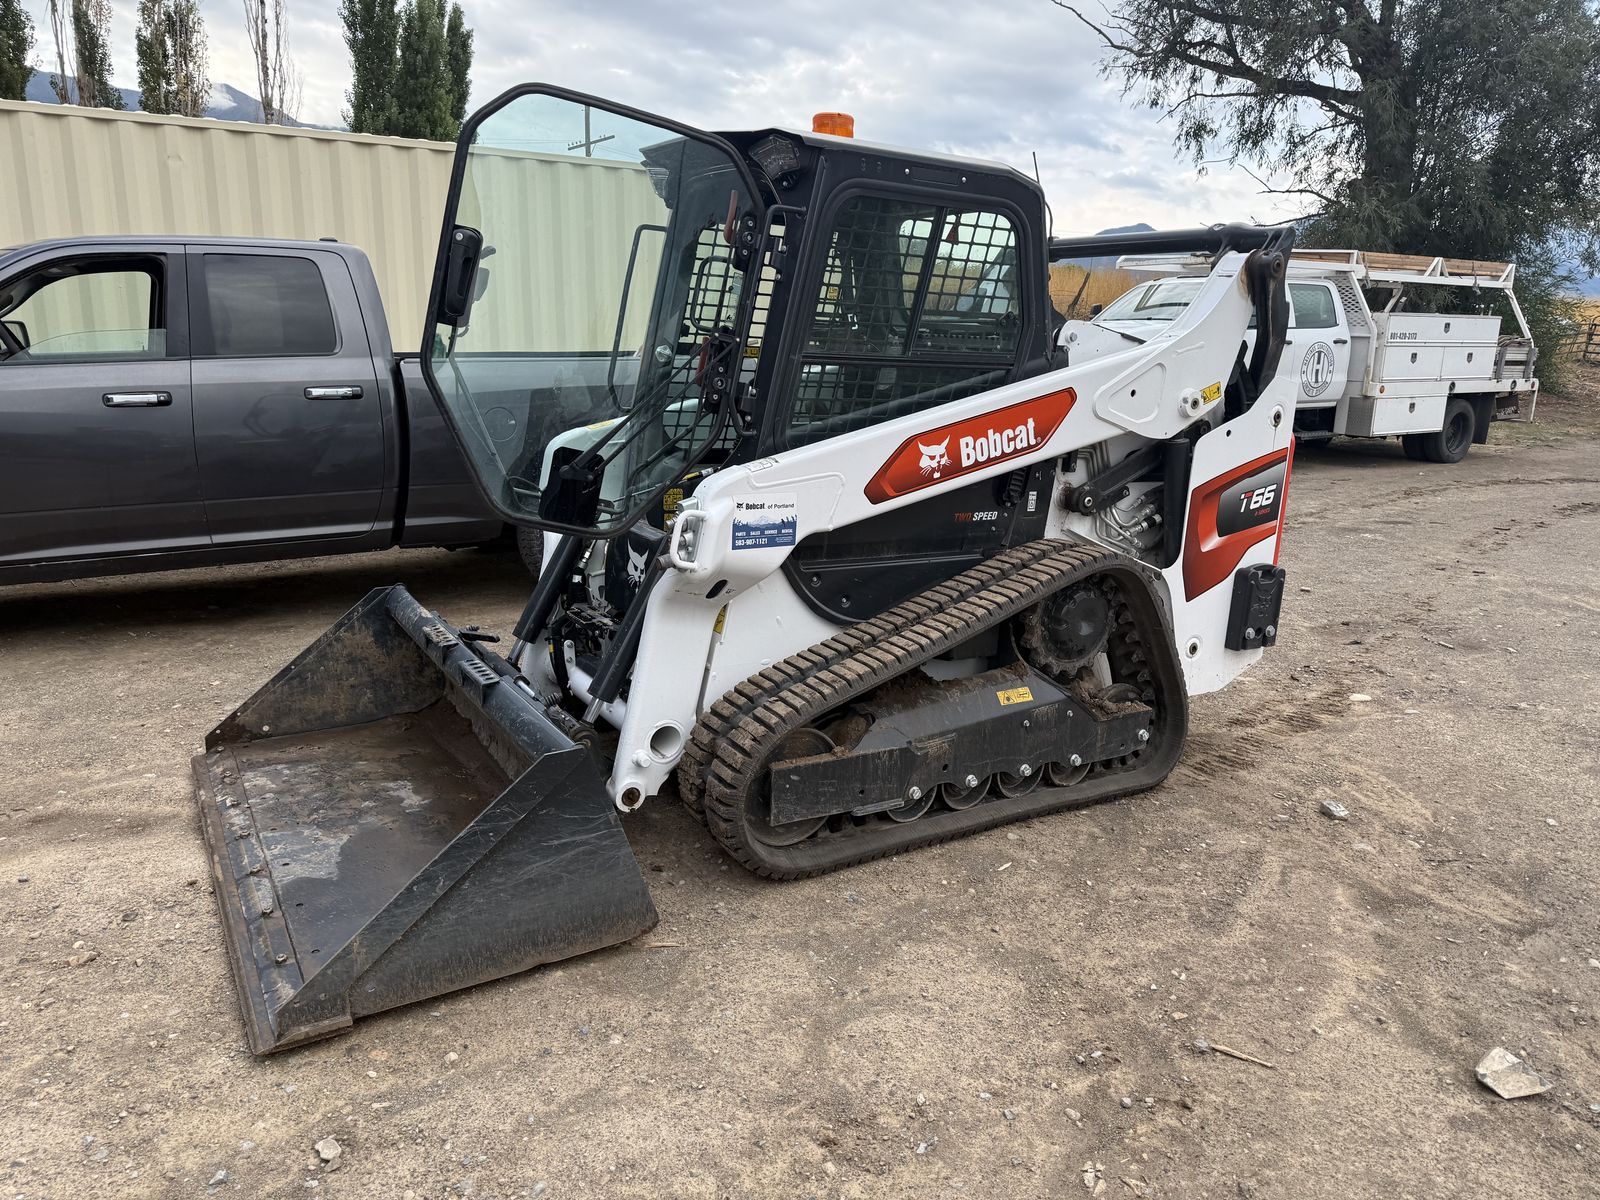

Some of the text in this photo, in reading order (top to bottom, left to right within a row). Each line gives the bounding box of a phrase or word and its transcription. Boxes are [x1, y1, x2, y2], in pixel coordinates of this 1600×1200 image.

[960, 417, 1036, 467] Bobcat
[745, 502, 765, 510] Bobcat
[1240, 484, 1277, 512] T66
[954, 511, 998, 521] TWO SPEED
